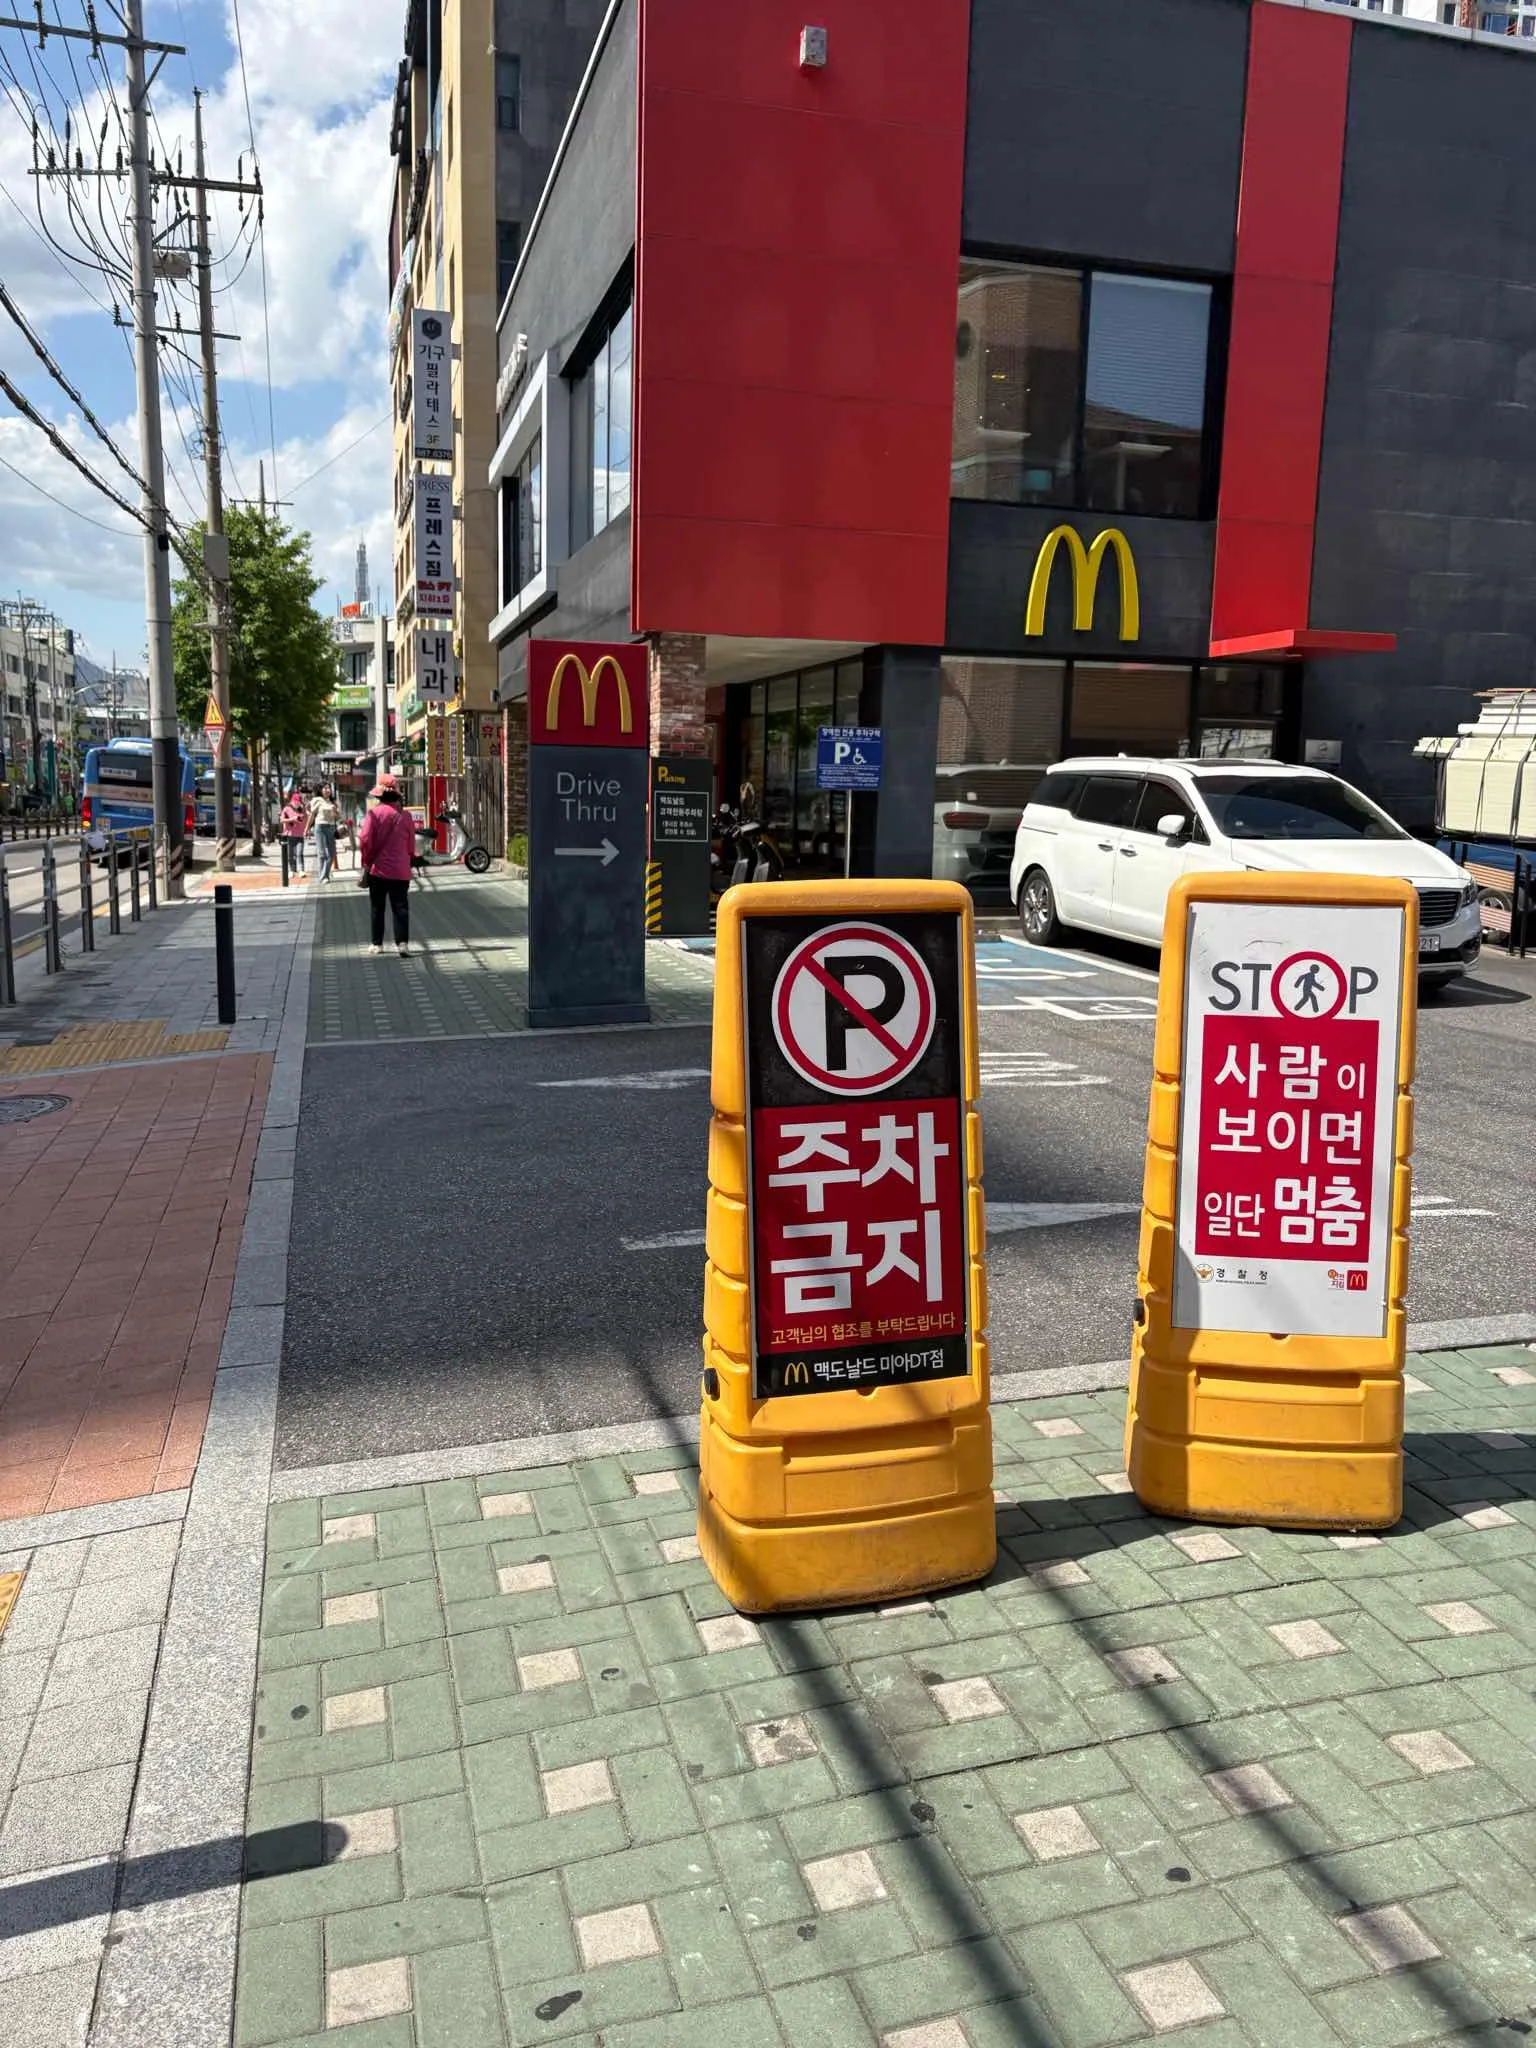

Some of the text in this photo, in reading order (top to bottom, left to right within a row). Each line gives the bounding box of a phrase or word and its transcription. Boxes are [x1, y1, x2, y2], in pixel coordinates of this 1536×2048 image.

[419, 344, 445, 361] 기구
[425, 362, 440, 428] 필라테스
[425, 497, 442, 578] 프레스짐
[421, 637, 449, 694] 내과
[657, 766, 686, 785] Parking
[834, 742, 851, 764] P
[556, 771, 621, 797] Drive
[660, 797, 685, 806] 맥도날드
[560, 798, 617, 824] Thru
[1207, 950, 1380, 1022] STOP
[1210, 1108, 1363, 1166] 보이면
[768, 1111, 949, 1213] 주차
[1204, 1175, 1365, 1248] 일단 멈춤
[771, 1210, 944, 1314] 금지
[771, 1312, 955, 1345] 고객님의 협조를 부탁드립니다
[814, 1356, 878, 1382] 맥도날드
[880, 1349, 944, 1375] 미아DT점
